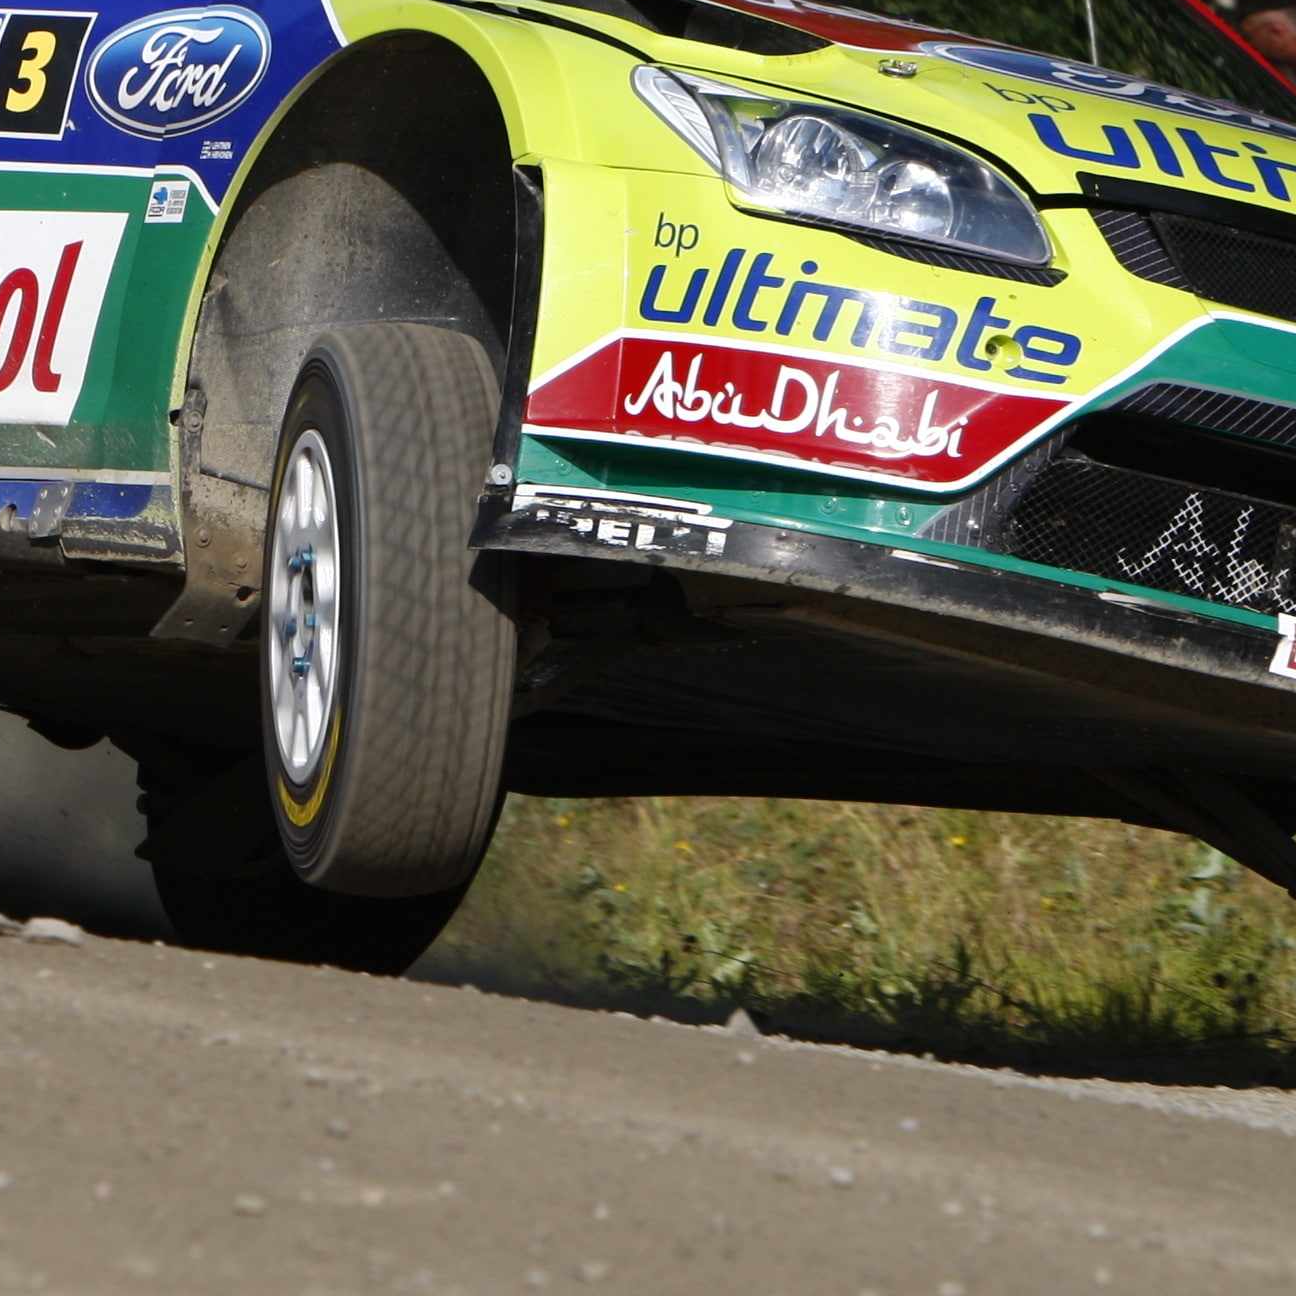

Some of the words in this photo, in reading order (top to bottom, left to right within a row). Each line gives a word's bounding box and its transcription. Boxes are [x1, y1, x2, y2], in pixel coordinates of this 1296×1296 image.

[5, 30, 57, 113] 3
[117, 25, 244, 112] Ford
[990, 83, 1075, 113] bp
[654, 211, 700, 259] bp
[639, 247, 1082, 386] ultimate
[624, 350, 768, 425] Abu
[764, 364, 971, 460] Dhabi
